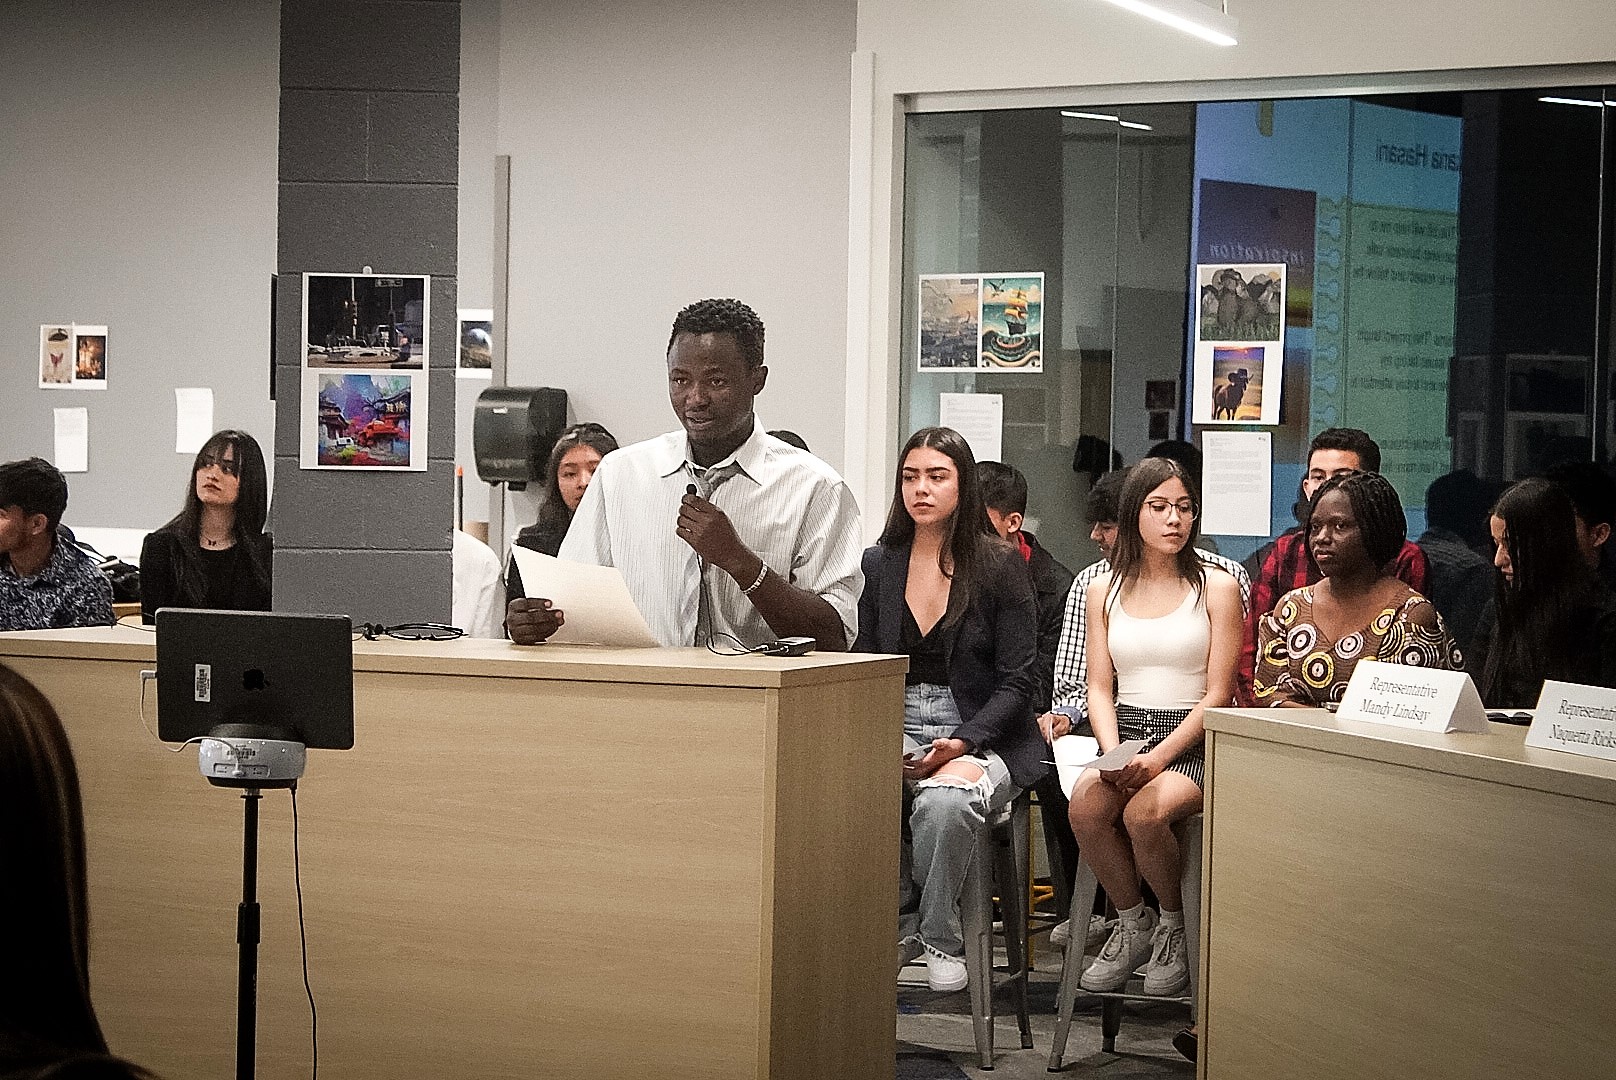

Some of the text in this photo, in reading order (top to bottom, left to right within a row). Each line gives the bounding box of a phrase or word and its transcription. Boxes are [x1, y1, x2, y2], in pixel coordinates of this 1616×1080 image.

[1369, 676, 1438, 699] Representative
[1360, 698, 1431, 725] Mandy Lindsay
